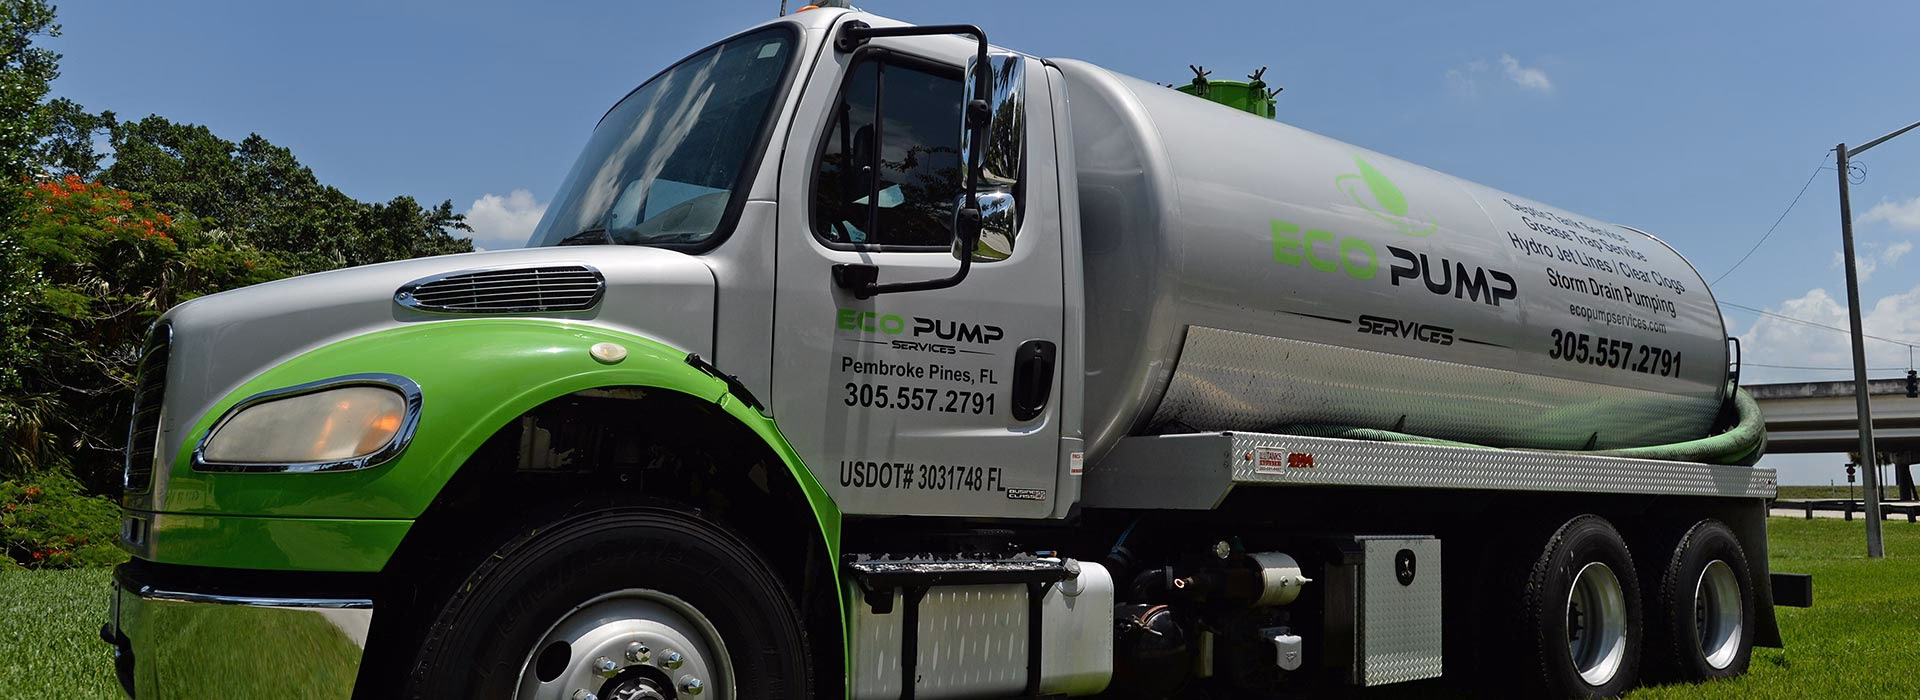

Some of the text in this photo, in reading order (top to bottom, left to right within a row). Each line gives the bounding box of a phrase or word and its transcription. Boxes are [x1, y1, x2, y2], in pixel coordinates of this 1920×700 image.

[1503, 198, 1629, 243] Septic Tank Service
[1522, 216, 1647, 262] Grease Trap Service
[1270, 218, 1518, 307] ECO PUMP
[1507, 231, 1553, 256] Hydro
[1556, 245, 1578, 265] Jet
[1576, 248, 1612, 273] Lines
[1619, 262, 1651, 284] Clear
[1651, 271, 1686, 294] Clogs
[1546, 267, 1677, 318] Storm Drain Pumping
[837, 308, 1004, 344] ECO PUMP
[1357, 314, 1455, 346] SERVICES
[1570, 303, 1668, 335] ecopumpservices.com
[891, 340, 956, 355] SERVICES
[1550, 328, 1682, 378] 305.557.2791
[842, 356, 998, 385] Pembroke Pines, FL
[844, 382, 996, 415] 305.557.2791
[840, 461, 1006, 492] USDOT# 3031748 FL
